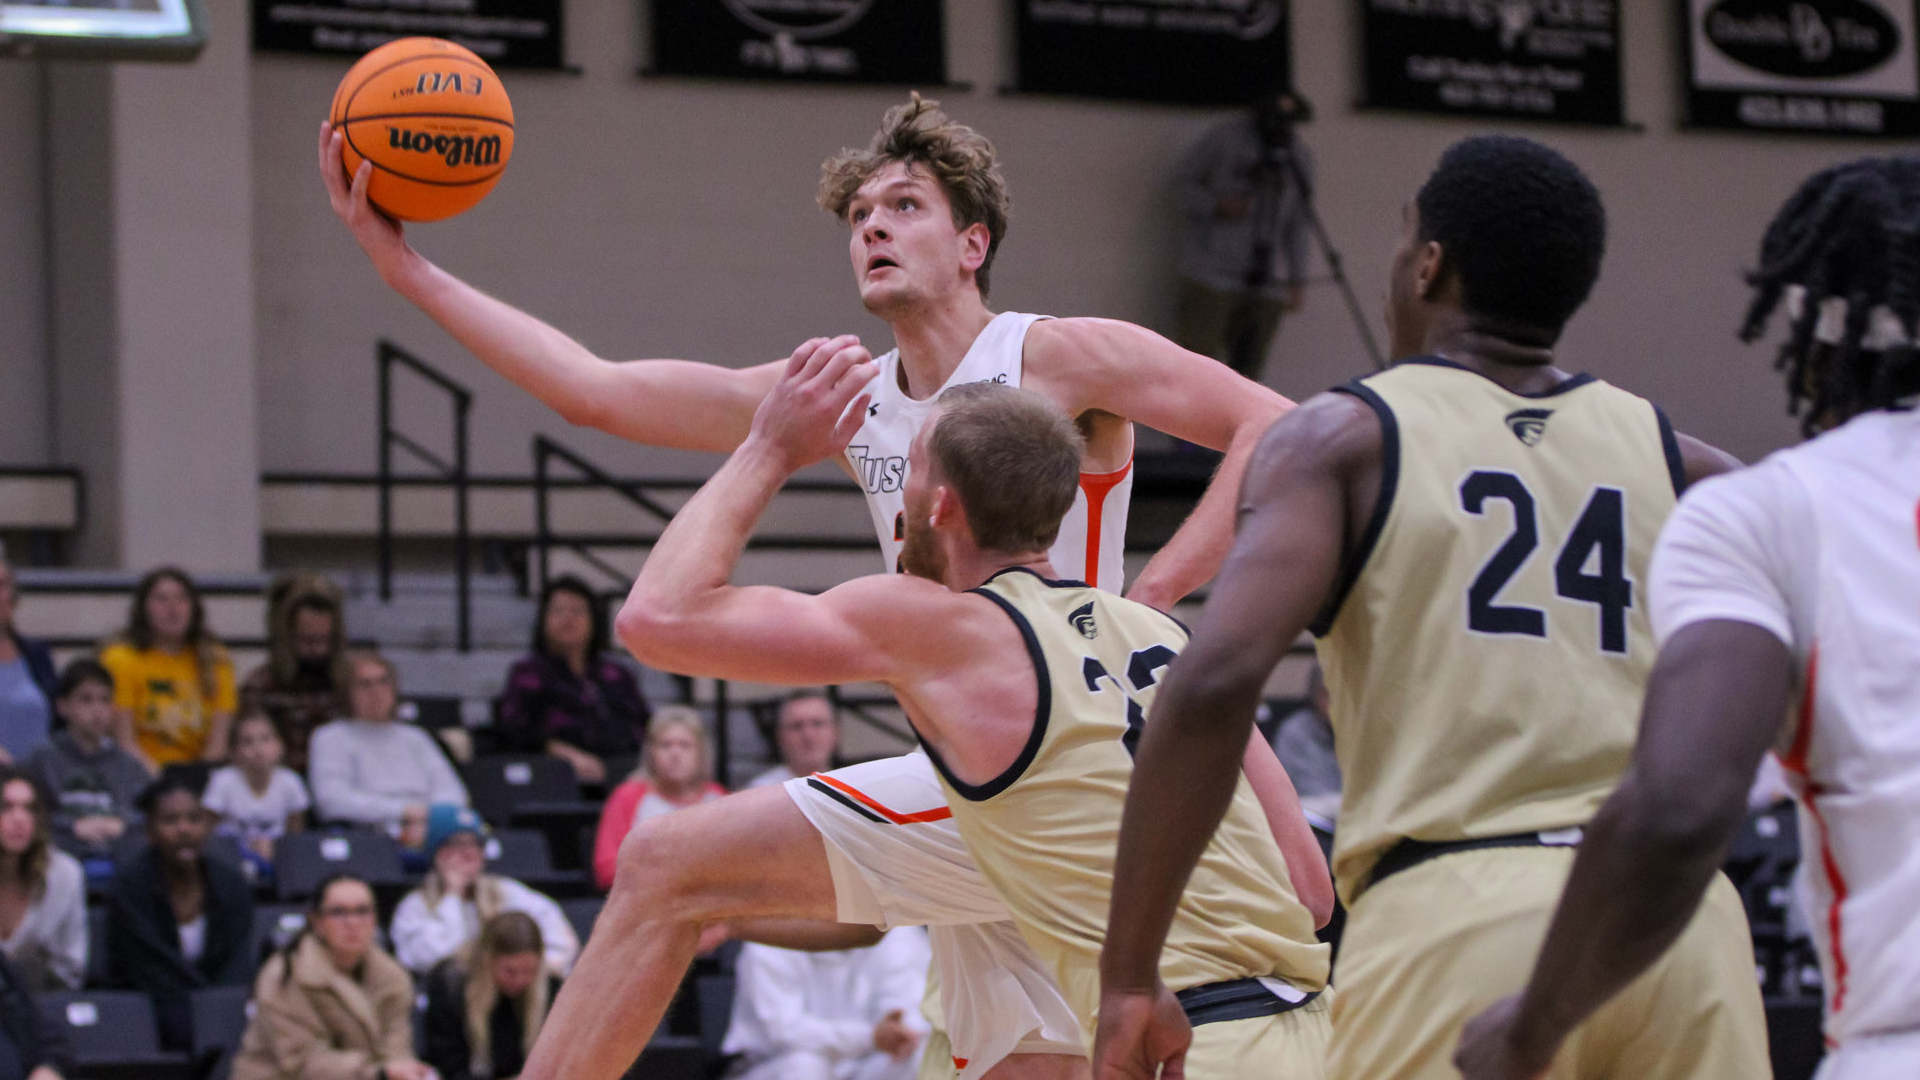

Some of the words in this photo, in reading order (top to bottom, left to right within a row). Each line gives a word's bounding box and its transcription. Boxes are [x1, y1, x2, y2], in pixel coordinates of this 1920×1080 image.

[416, 72, 483, 95] EVO
[390, 127, 502, 168] Wilson
[1458, 469, 1634, 656] 24
